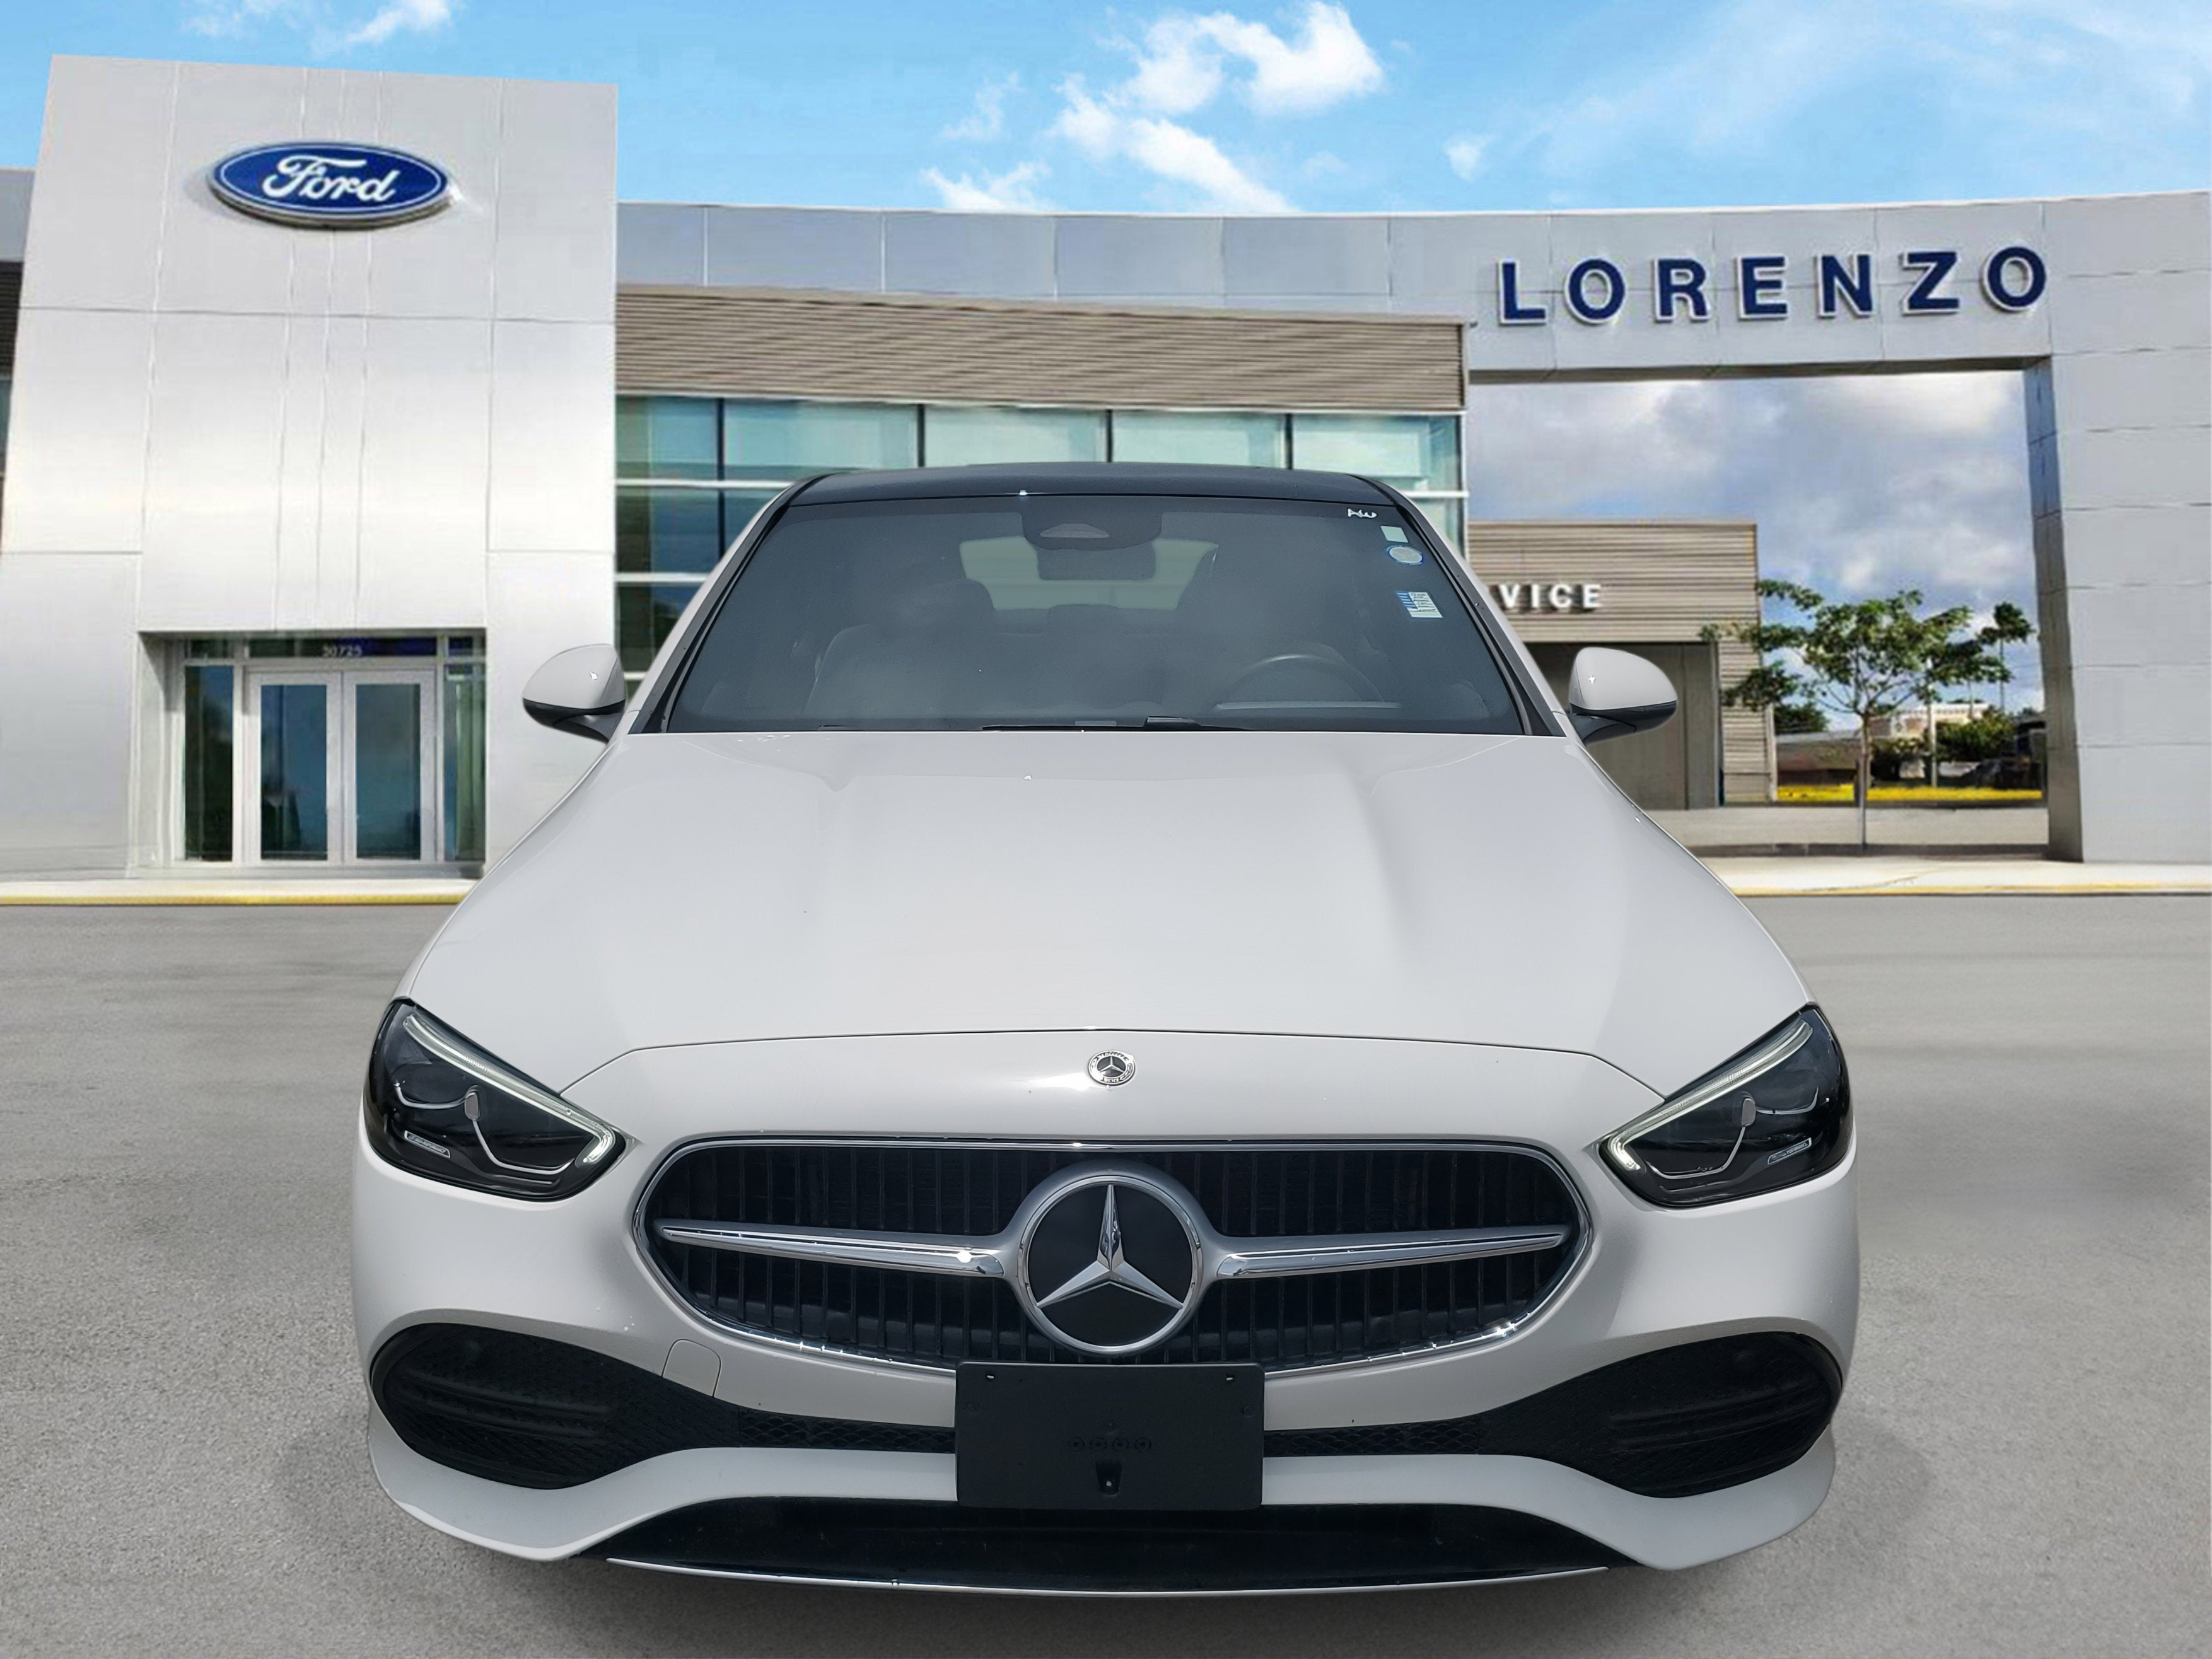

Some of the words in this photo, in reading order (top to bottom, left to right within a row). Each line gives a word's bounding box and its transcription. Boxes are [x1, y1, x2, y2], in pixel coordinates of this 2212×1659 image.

[262, 154, 401, 202] Ford
[1498, 246, 2047, 325] LORENZO
[1498, 583, 1603, 609] VICE
